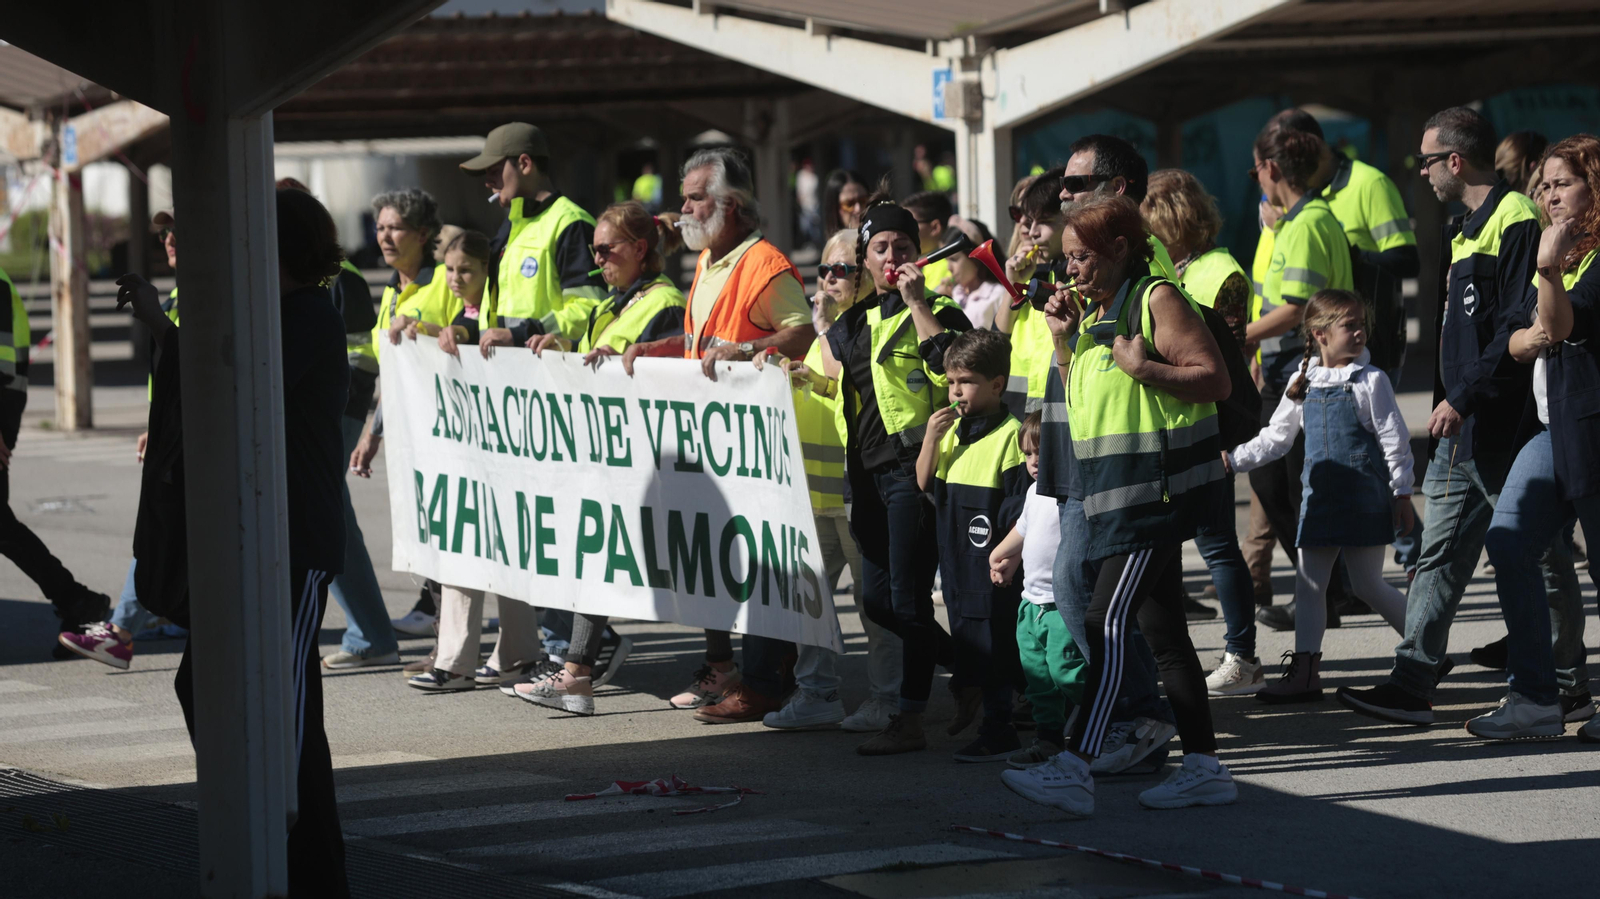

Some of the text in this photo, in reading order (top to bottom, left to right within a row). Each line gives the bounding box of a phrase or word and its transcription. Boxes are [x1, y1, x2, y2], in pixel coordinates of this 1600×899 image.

[580, 393, 632, 468] DE
[639, 399, 792, 487] VECINOS
[413, 468, 823, 619] BAHIA DE PALMONES
